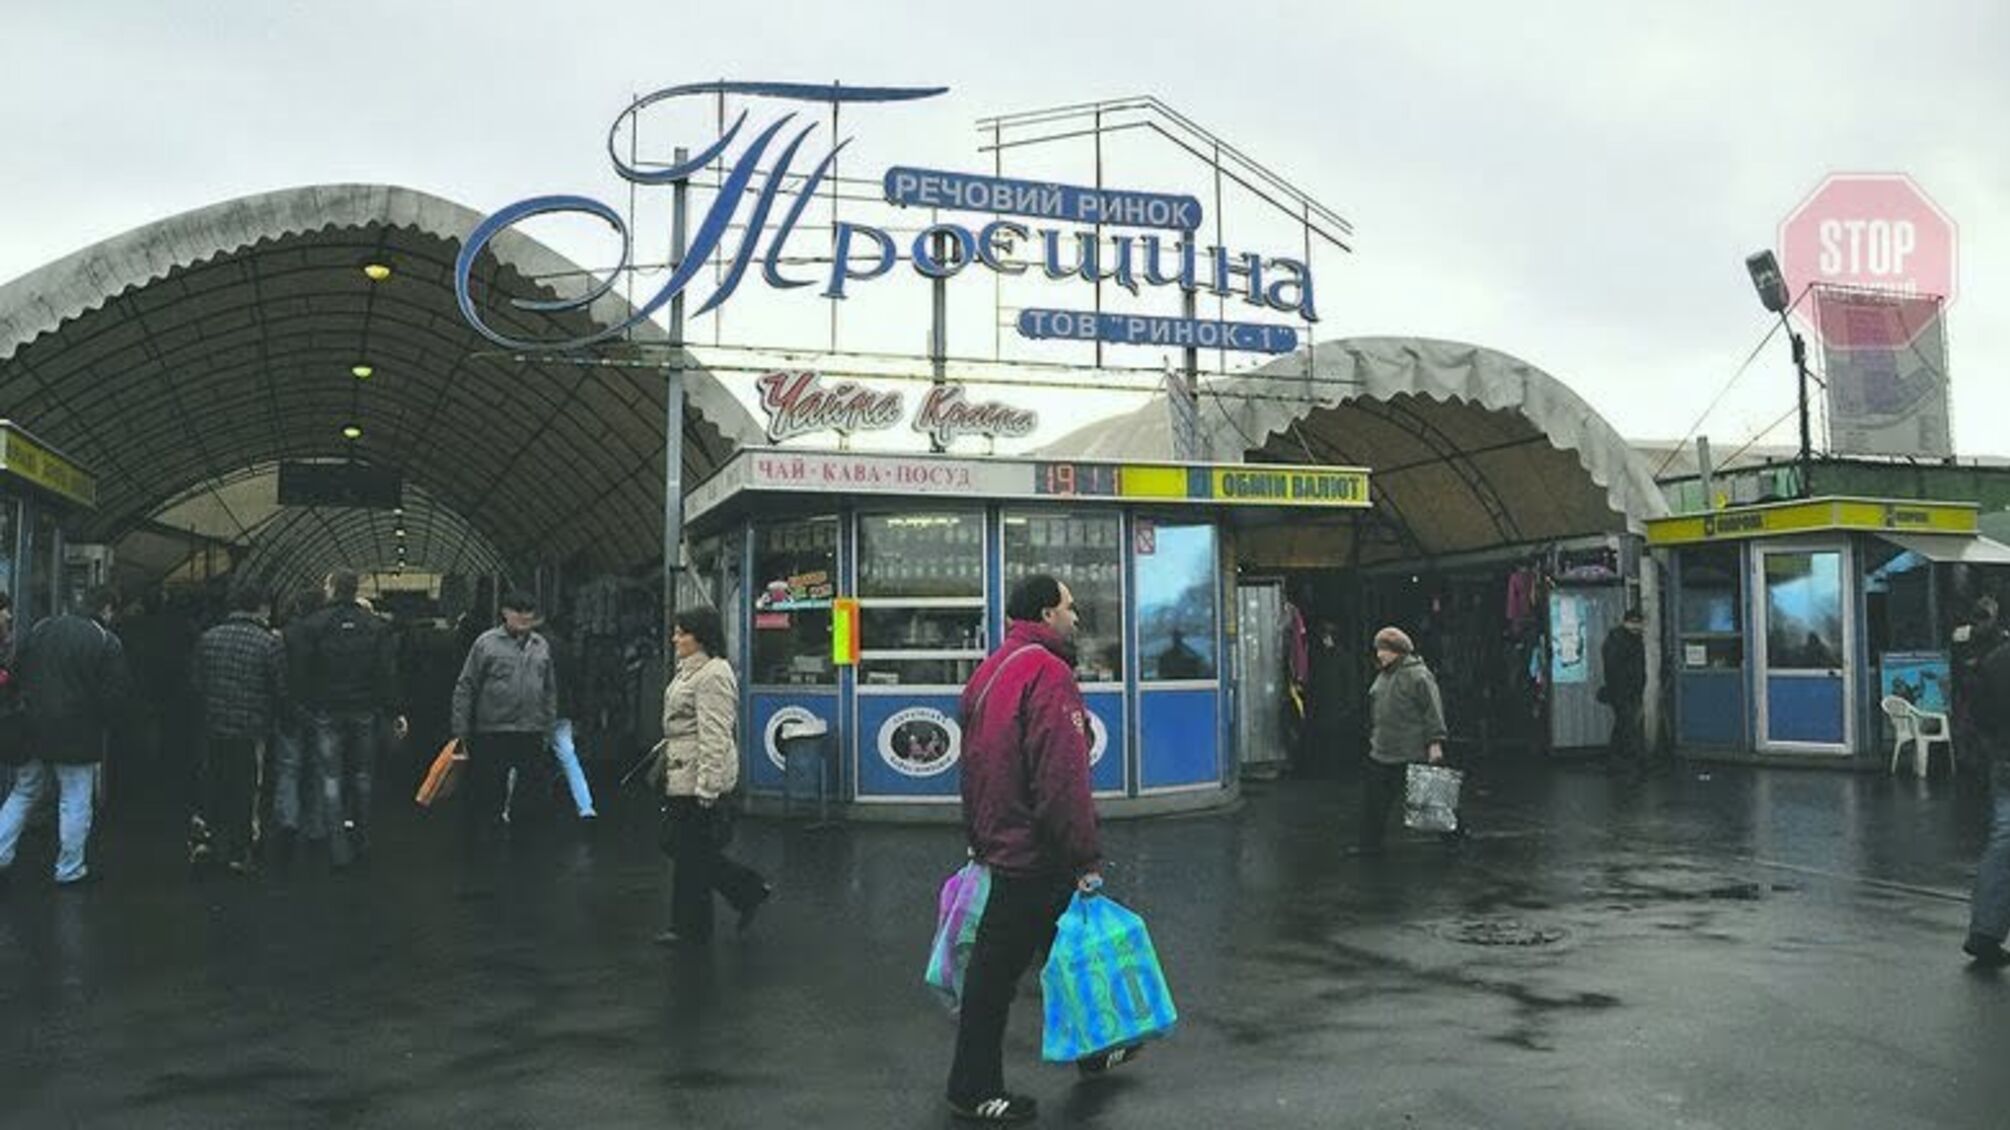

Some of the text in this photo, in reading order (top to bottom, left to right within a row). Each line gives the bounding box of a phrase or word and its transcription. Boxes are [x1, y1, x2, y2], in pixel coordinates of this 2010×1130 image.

[455, 81, 1319, 350] Троєщина
[894, 173, 1192, 229] РЕЧОВИЙ РИНОК
[1030, 311, 1291, 350] ТОВ "РИНОК-1"
[758, 458, 972, 488] ЧАЙ КАВА ПОСУД
